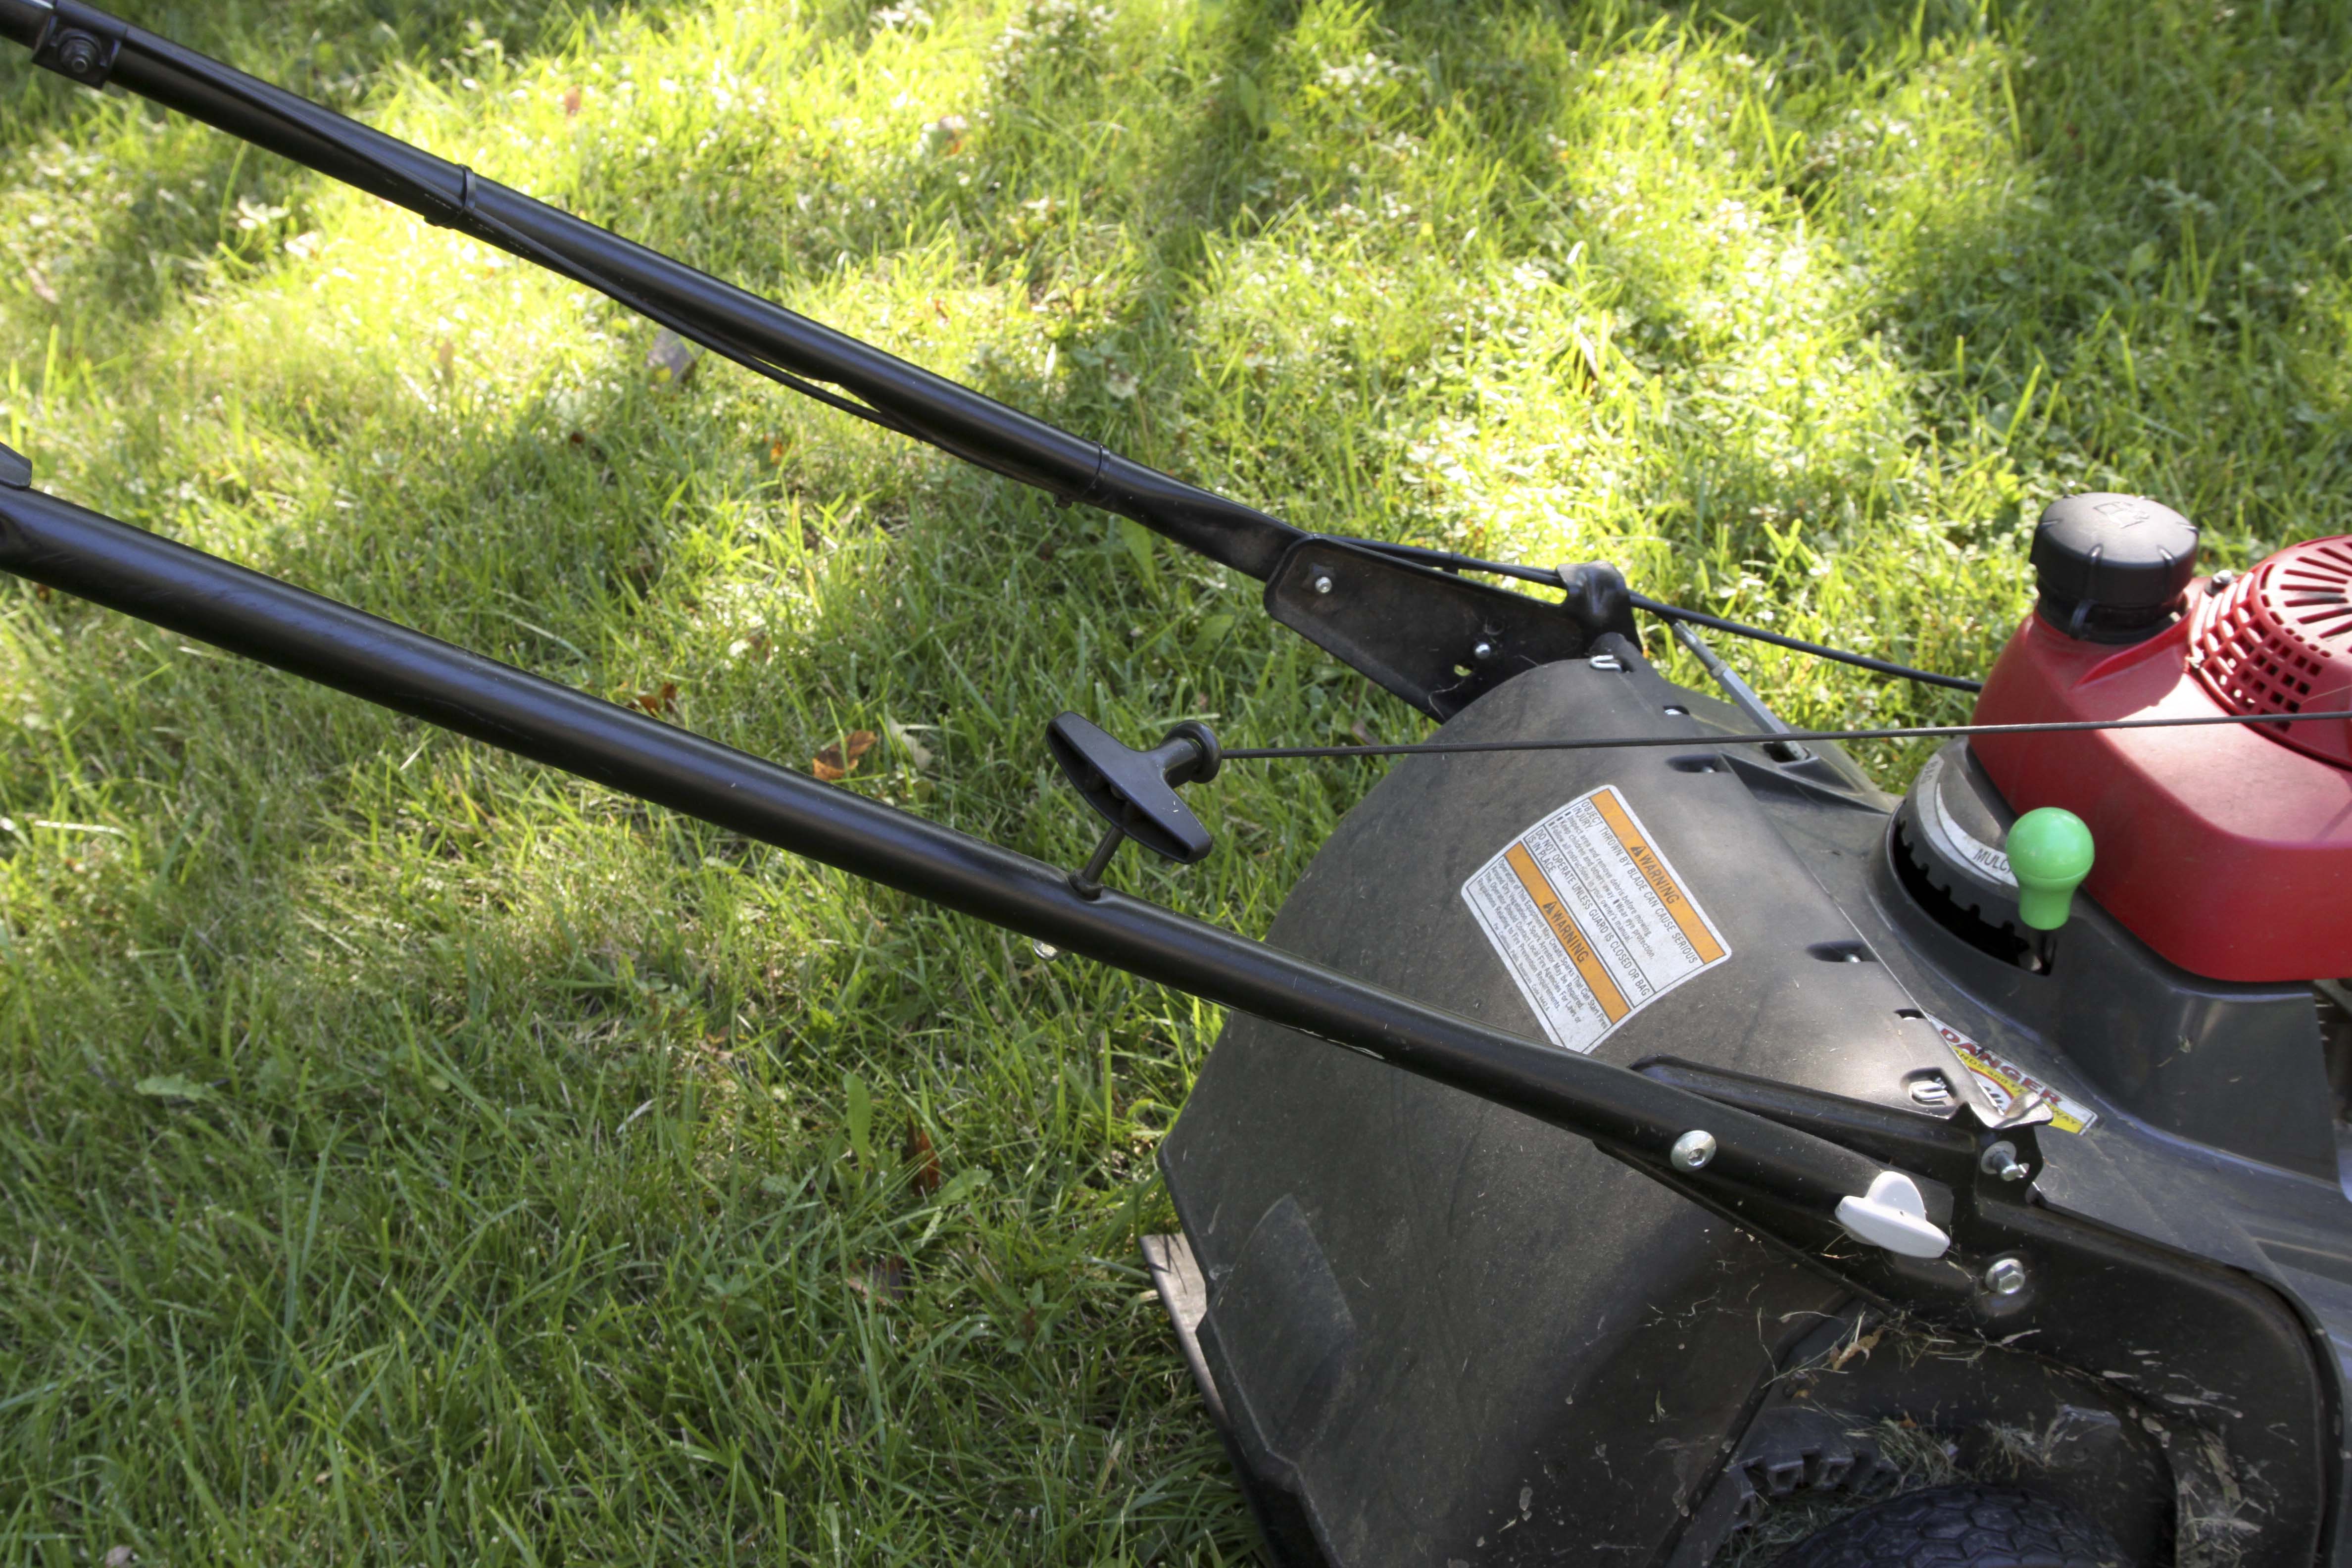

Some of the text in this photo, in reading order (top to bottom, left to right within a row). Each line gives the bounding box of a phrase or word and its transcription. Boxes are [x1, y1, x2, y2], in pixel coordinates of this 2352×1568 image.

[1571, 805, 1593, 832] INJURY.
[1550, 824, 1566, 843] Follow
[1562, 841, 1571, 850] all
[1526, 833, 1557, 873] IS IN PLACE
[1566, 848, 1591, 881] instructions
[1566, 815, 1584, 836] Inspect
[1579, 834, 1591, 847] area
[1588, 846, 1600, 859] and
[1595, 857, 1613, 879] remove
[1609, 877, 1625, 896] debris
[1621, 894, 1638, 915] before
[1973, 848, 2011, 873] MULC
[1497, 859, 1518, 885] Operation
[1580, 800, 1699, 964] OBJECT THROWN BY BLADE CAN CAUSE SERIOUS
[1587, 879, 1596, 887] in
[1638, 853, 1680, 905] WARNING
[1517, 888, 1528, 902] This
[1568, 833, 1586, 856] children
[1582, 854, 1594, 867] and
[1590, 865, 1606, 884] others
[1615, 902, 1629, 918] Wear
[1623, 918, 1635, 931] eye
[1631, 928, 1657, 960] protection.
[1590, 887, 1603, 901] your
[1490, 865, 1506, 885] Around
[1527, 925, 1543, 943] Spark
[1538, 940, 1556, 964] Arrestor
[1551, 962, 1565, 978] May
[1560, 975, 1569, 984] be
[1522, 899, 1546, 930] Equipment
[1535, 828, 1651, 996] DO NOT OPERATE UNLESS GUARD IS CLOSED OR BAG
[1539, 926, 1553, 941] May
[1549, 910, 1590, 964] WARNING
[1489, 881, 1508, 905] Operator
[1515, 921, 1532, 943] Contact
[1527, 941, 1541, 957] Local
[1536, 955, 1548, 968] Fire
[1542, 967, 1563, 994] Agencies
[1558, 991, 1569, 1003] For
[1564, 1001, 1578, 1017] Laws
[1507, 927, 1515, 935] to
[1511, 932, 1522, 945] Fire
[1517, 943, 1539, 973] Prevention
[1548, 937, 1565, 958] Create
[1559, 957, 1577, 978] Sparks
[1571, 975, 1585, 989] That
[1579, 987, 1592, 1001] Can
[1587, 999, 1601, 1015] Start
[1940, 1028, 2062, 1106] DANGER
